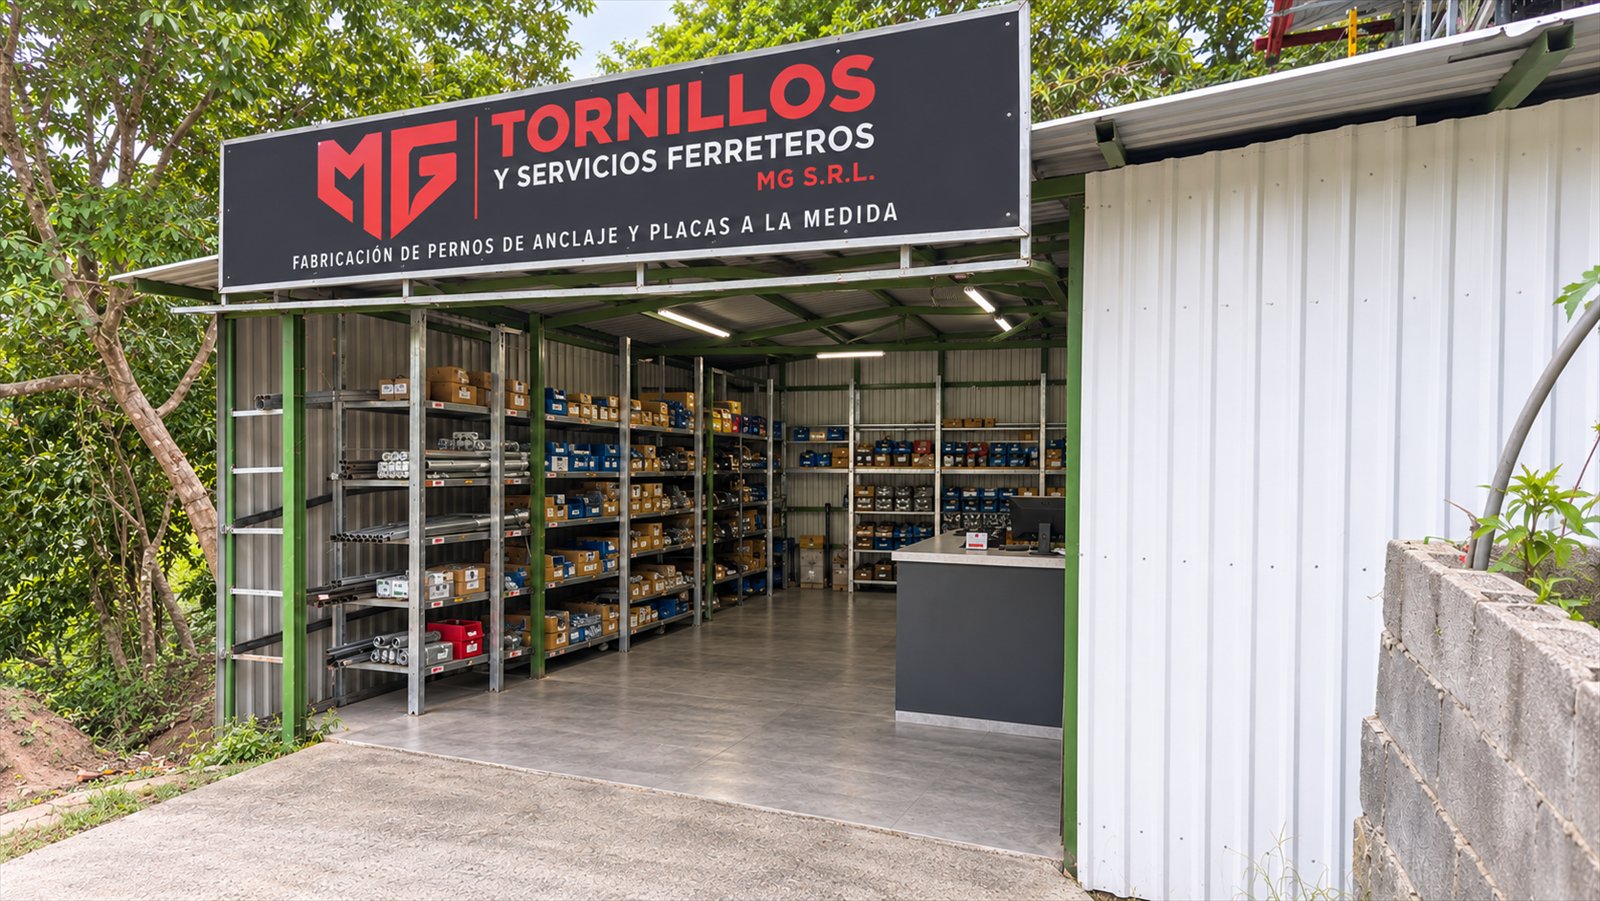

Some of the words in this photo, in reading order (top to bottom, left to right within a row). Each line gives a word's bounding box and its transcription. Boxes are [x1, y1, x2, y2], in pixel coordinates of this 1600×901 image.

[491, 53, 876, 158] TORNILLOS
[317, 119, 458, 241] MG
[493, 167, 510, 190] Y
[516, 147, 658, 188] SERVICIOS
[666, 122, 875, 171] FERRETEROS
[757, 168, 795, 191] MG
[803, 160, 875, 187] S.R.L.
[292, 246, 393, 270] FABRICACIÓN
[400, 244, 420, 262] DE
[428, 237, 494, 259] PERNOS
[502, 234, 524, 252] DE
[532, 226, 618, 251] ANCLAJE
[628, 224, 640, 243] Y
[649, 216, 730, 241] PLACAS
[740, 215, 754, 234] A
[765, 212, 792, 231] LA
[803, 201, 898, 229] MEDIDA
